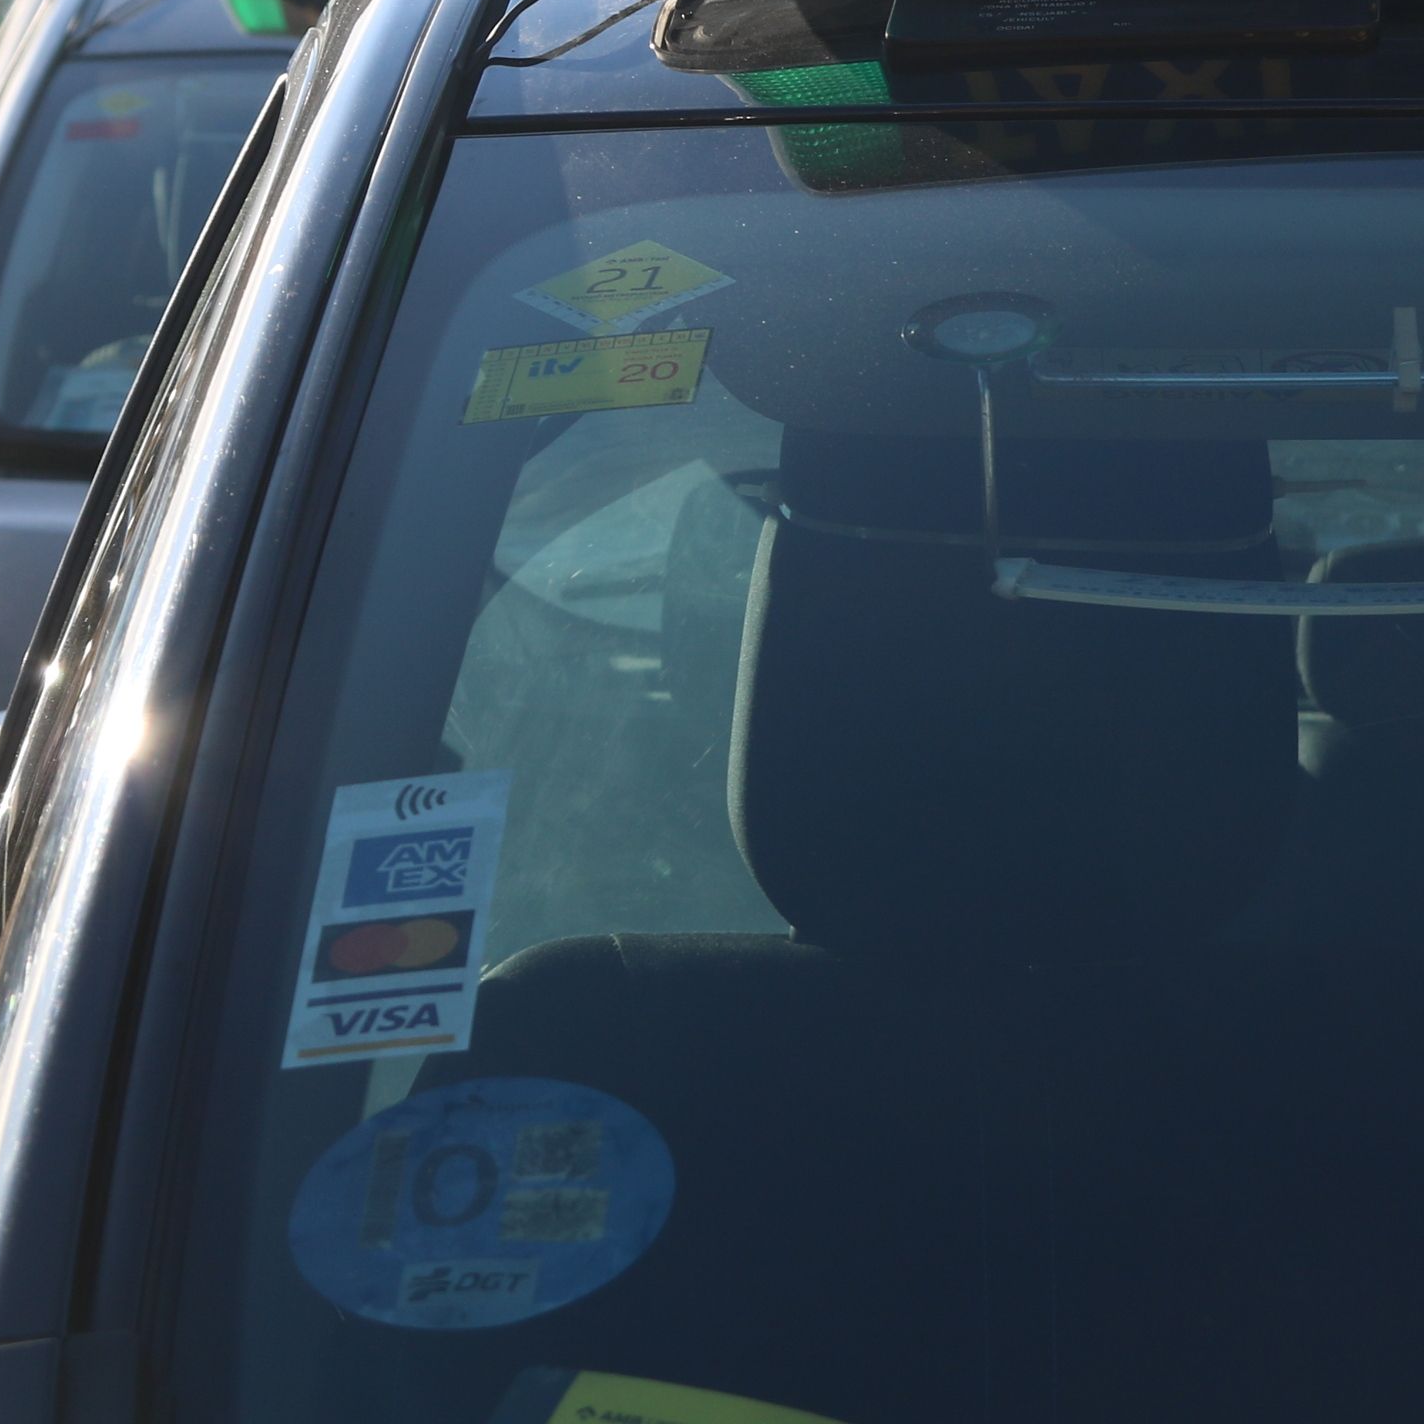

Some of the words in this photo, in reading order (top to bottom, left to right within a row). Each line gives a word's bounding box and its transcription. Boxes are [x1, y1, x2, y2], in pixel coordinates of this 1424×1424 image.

[586, 265, 664, 294] 21
[617, 360, 680, 385] 20
[377, 837, 472, 873] AM
[386, 864, 468, 893] EX
[326, 1001, 441, 1037] VISA
[452, 1270, 533, 1294] DGT
